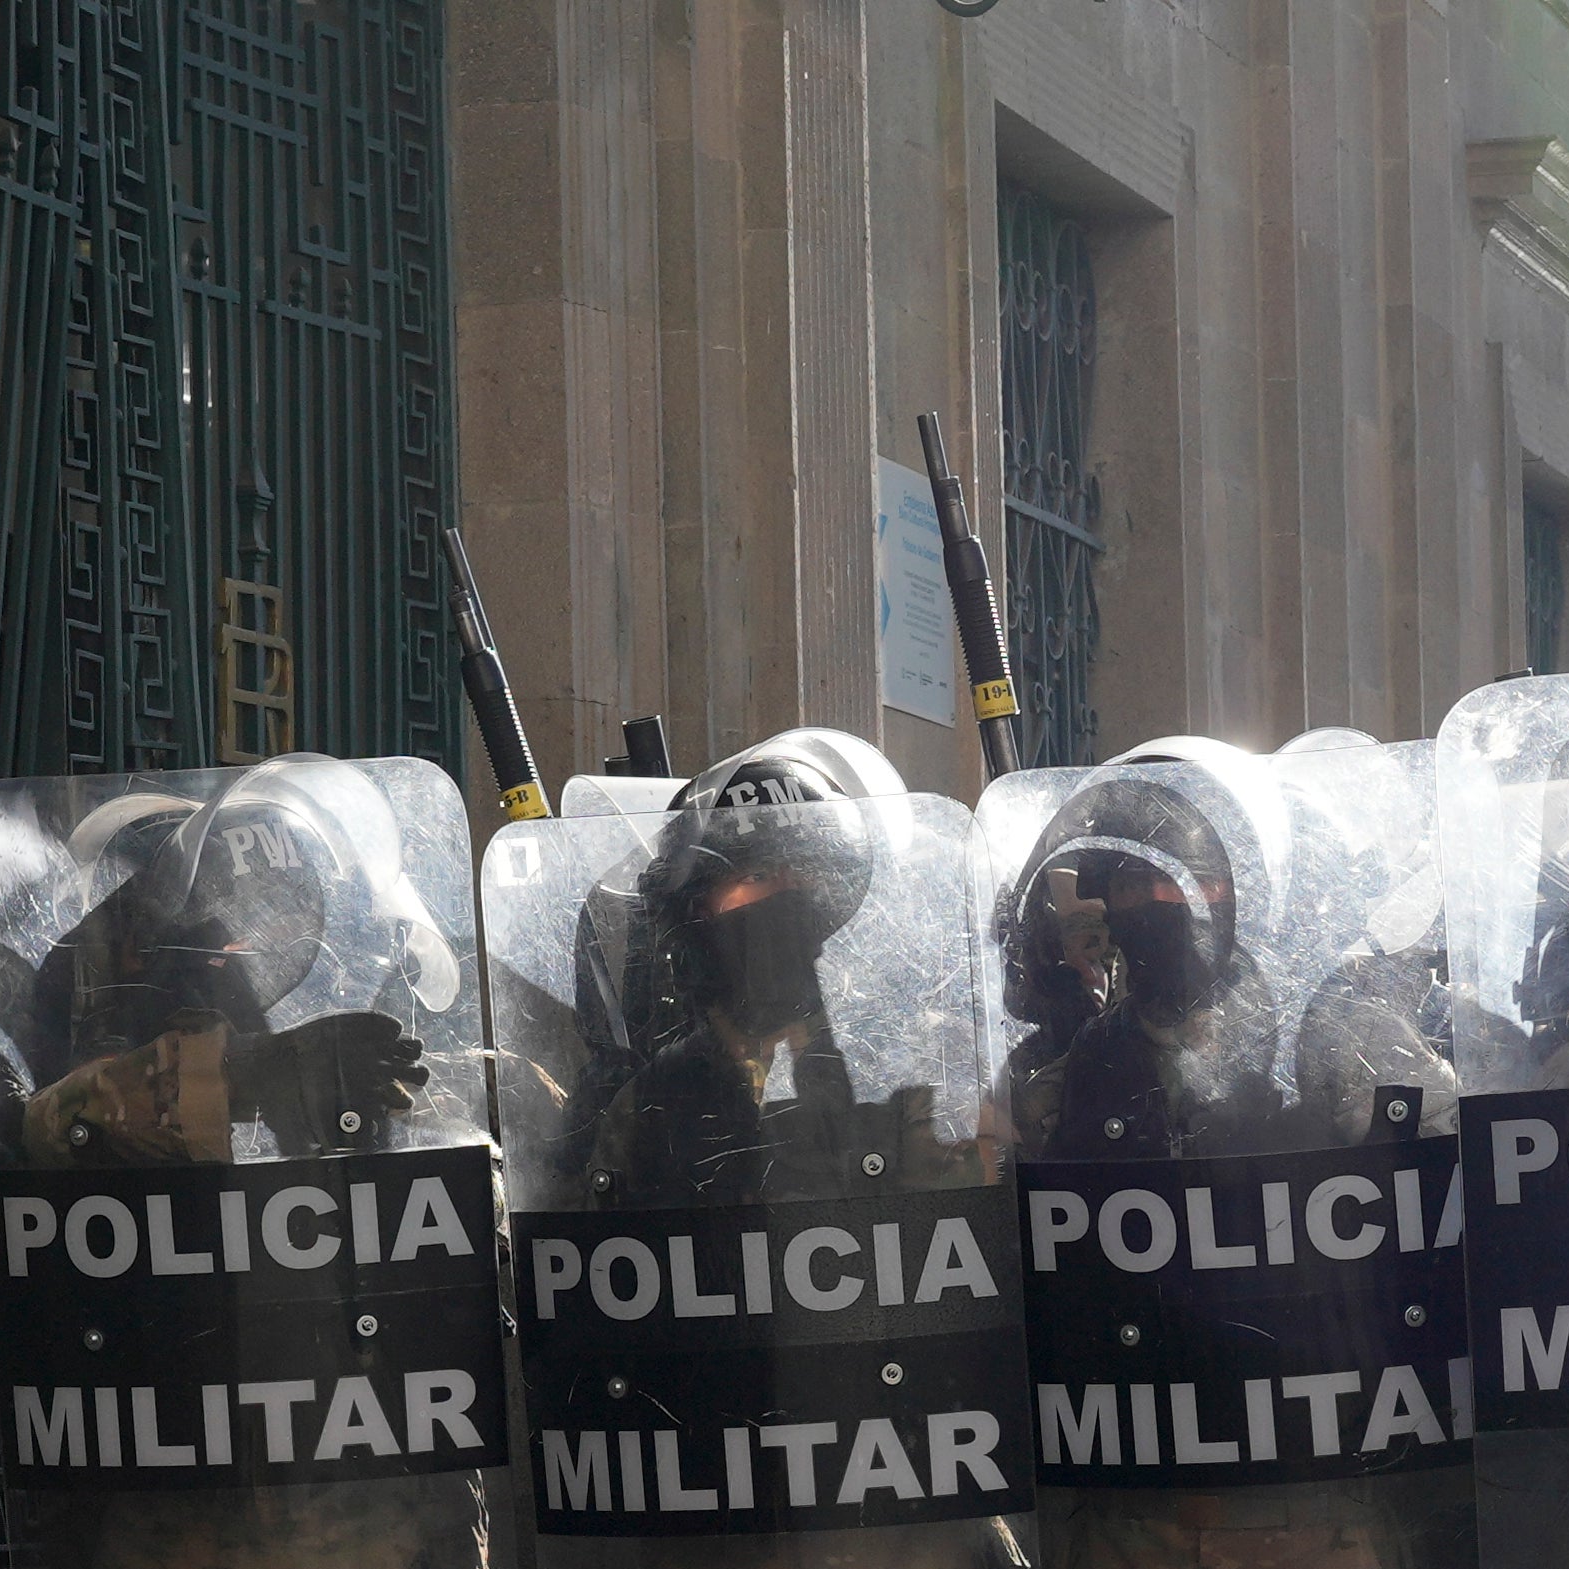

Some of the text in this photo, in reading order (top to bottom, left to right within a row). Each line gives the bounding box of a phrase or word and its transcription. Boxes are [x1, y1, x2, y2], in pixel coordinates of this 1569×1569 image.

[222, 822, 303, 877] PM
[4, 1177, 473, 1277] POLICIA
[532, 1217, 998, 1321] POLICIA
[13, 1369, 484, 1468] MILITAR
[543, 1410, 1009, 1512] MILITAR
